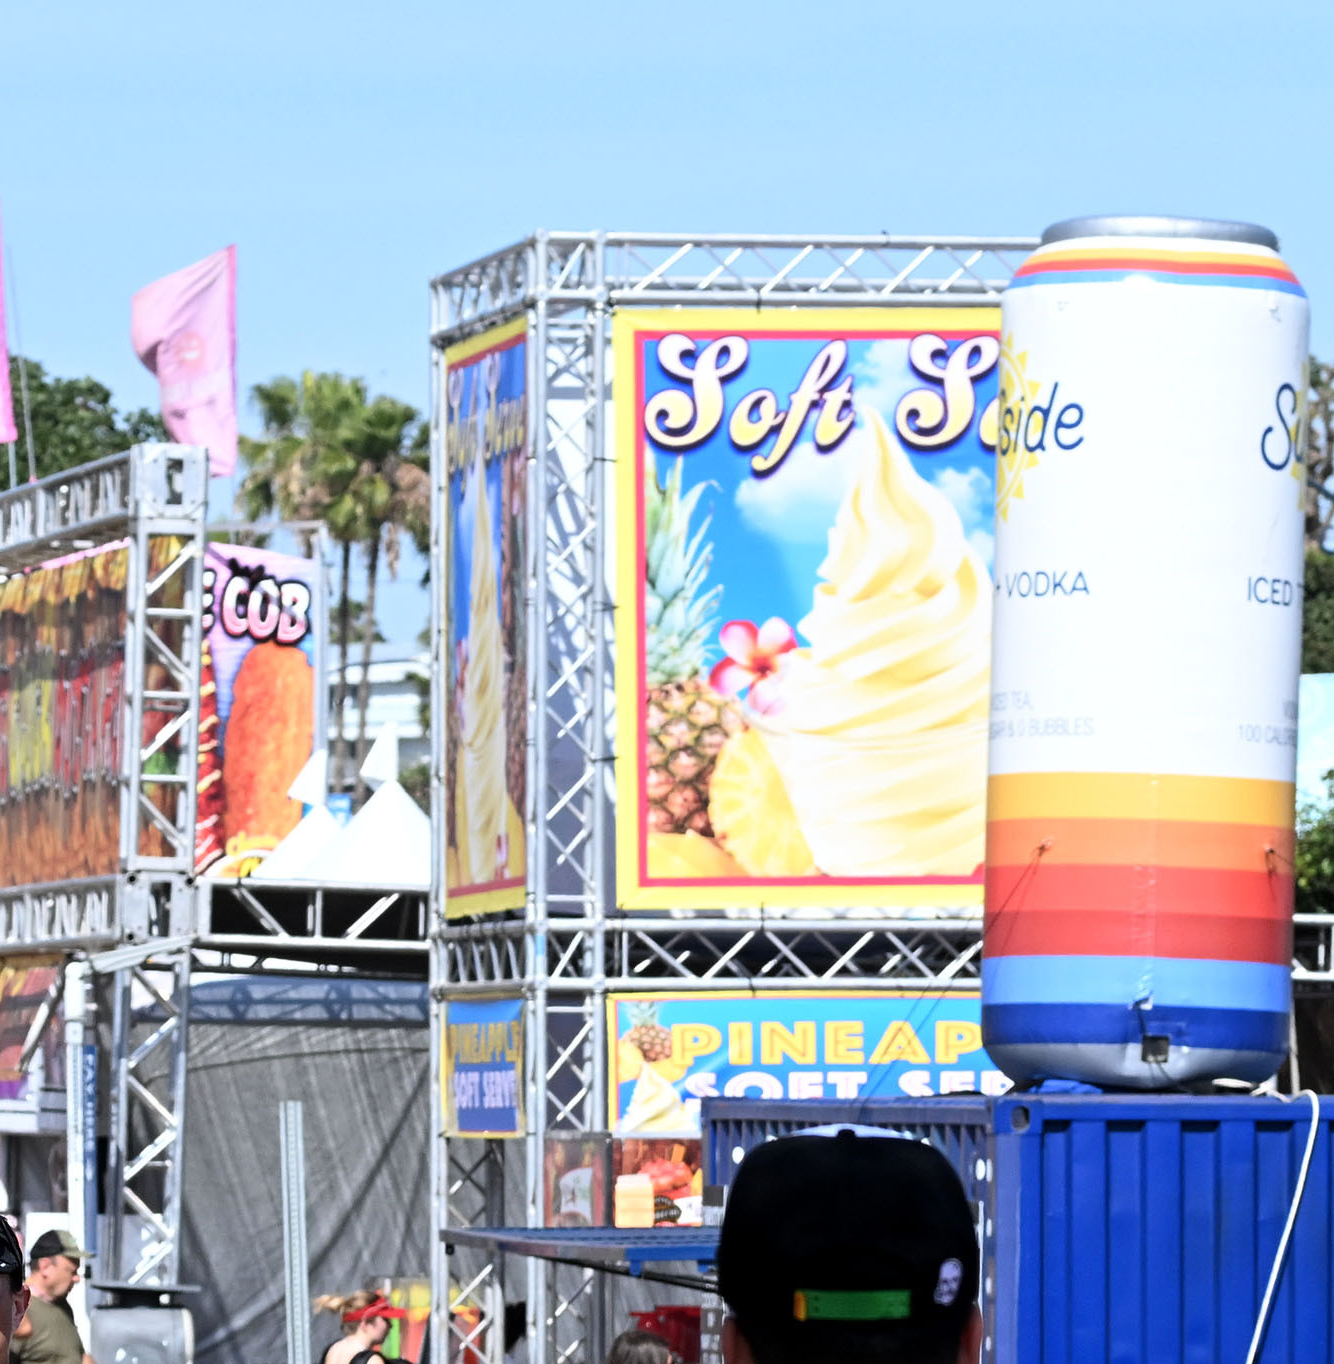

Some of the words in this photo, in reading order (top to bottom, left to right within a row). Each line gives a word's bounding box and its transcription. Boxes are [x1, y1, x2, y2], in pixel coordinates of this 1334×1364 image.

[644, 334, 855, 478] Soft
[1005, 571, 1090, 598] VODKA
[1247, 576, 1293, 607] ICED
[222, 575, 311, 645] COB
[670, 1021, 983, 1065] PINEAP
[898, 1070, 1014, 1098] SER
